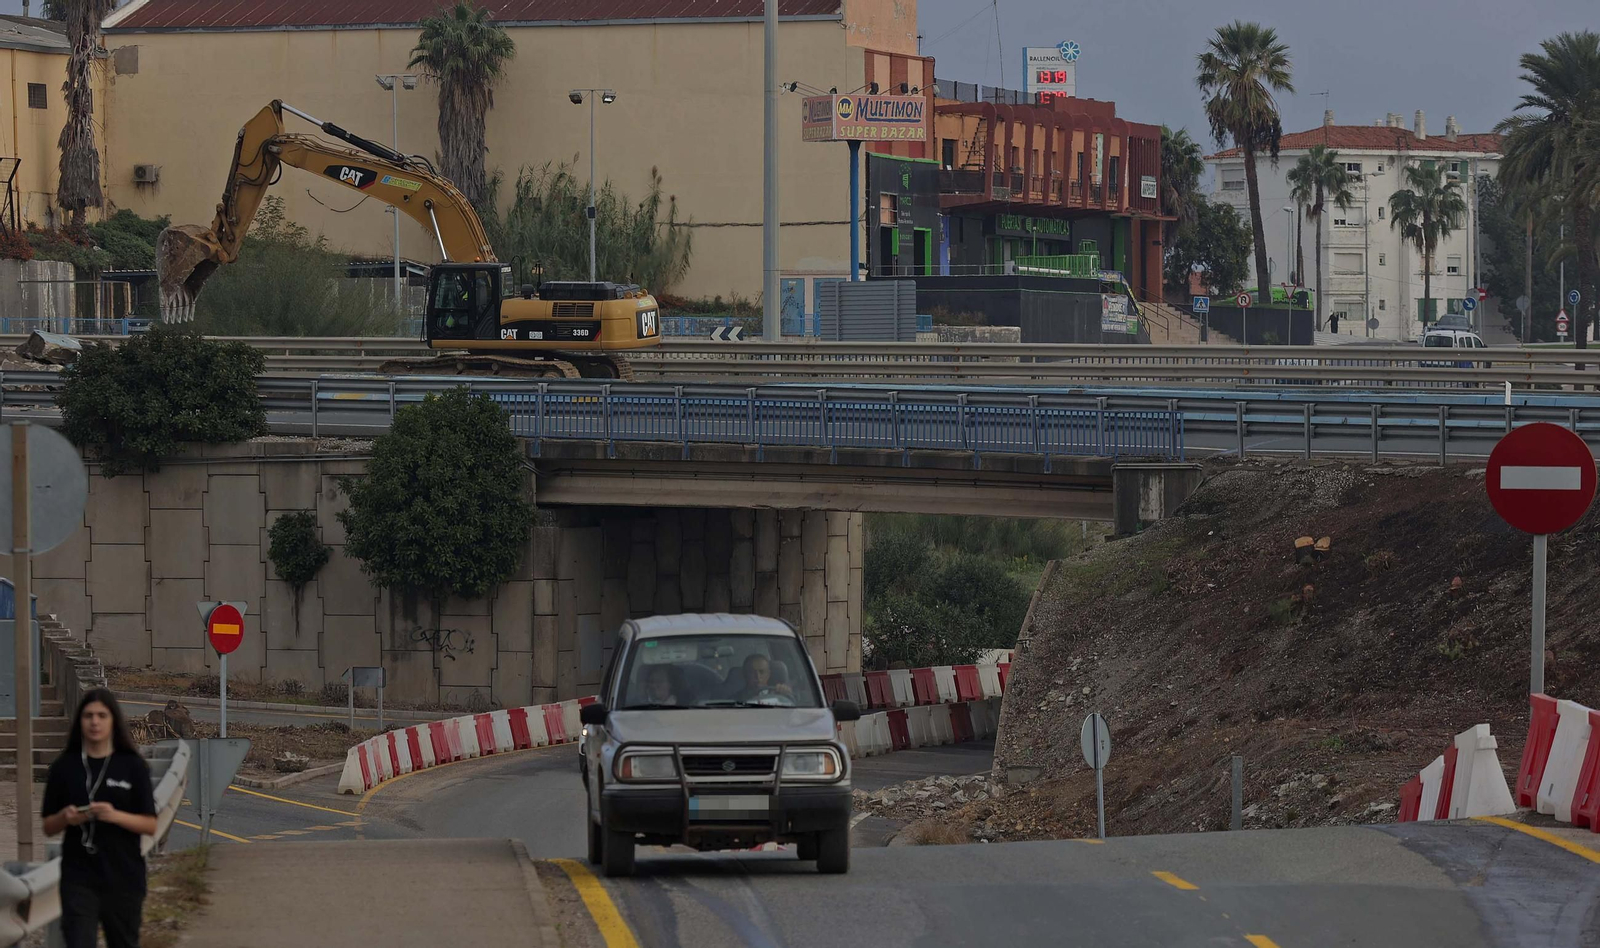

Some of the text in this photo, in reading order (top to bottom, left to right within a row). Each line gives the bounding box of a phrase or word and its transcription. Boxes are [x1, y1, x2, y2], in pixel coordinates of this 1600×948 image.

[855, 97, 923, 122] MULTIMON
[840, 126, 924, 139] SUPER BAZAR
[340, 166, 364, 187] CAT
[500, 328, 518, 340] CAT
[642, 311, 656, 337] CAT
